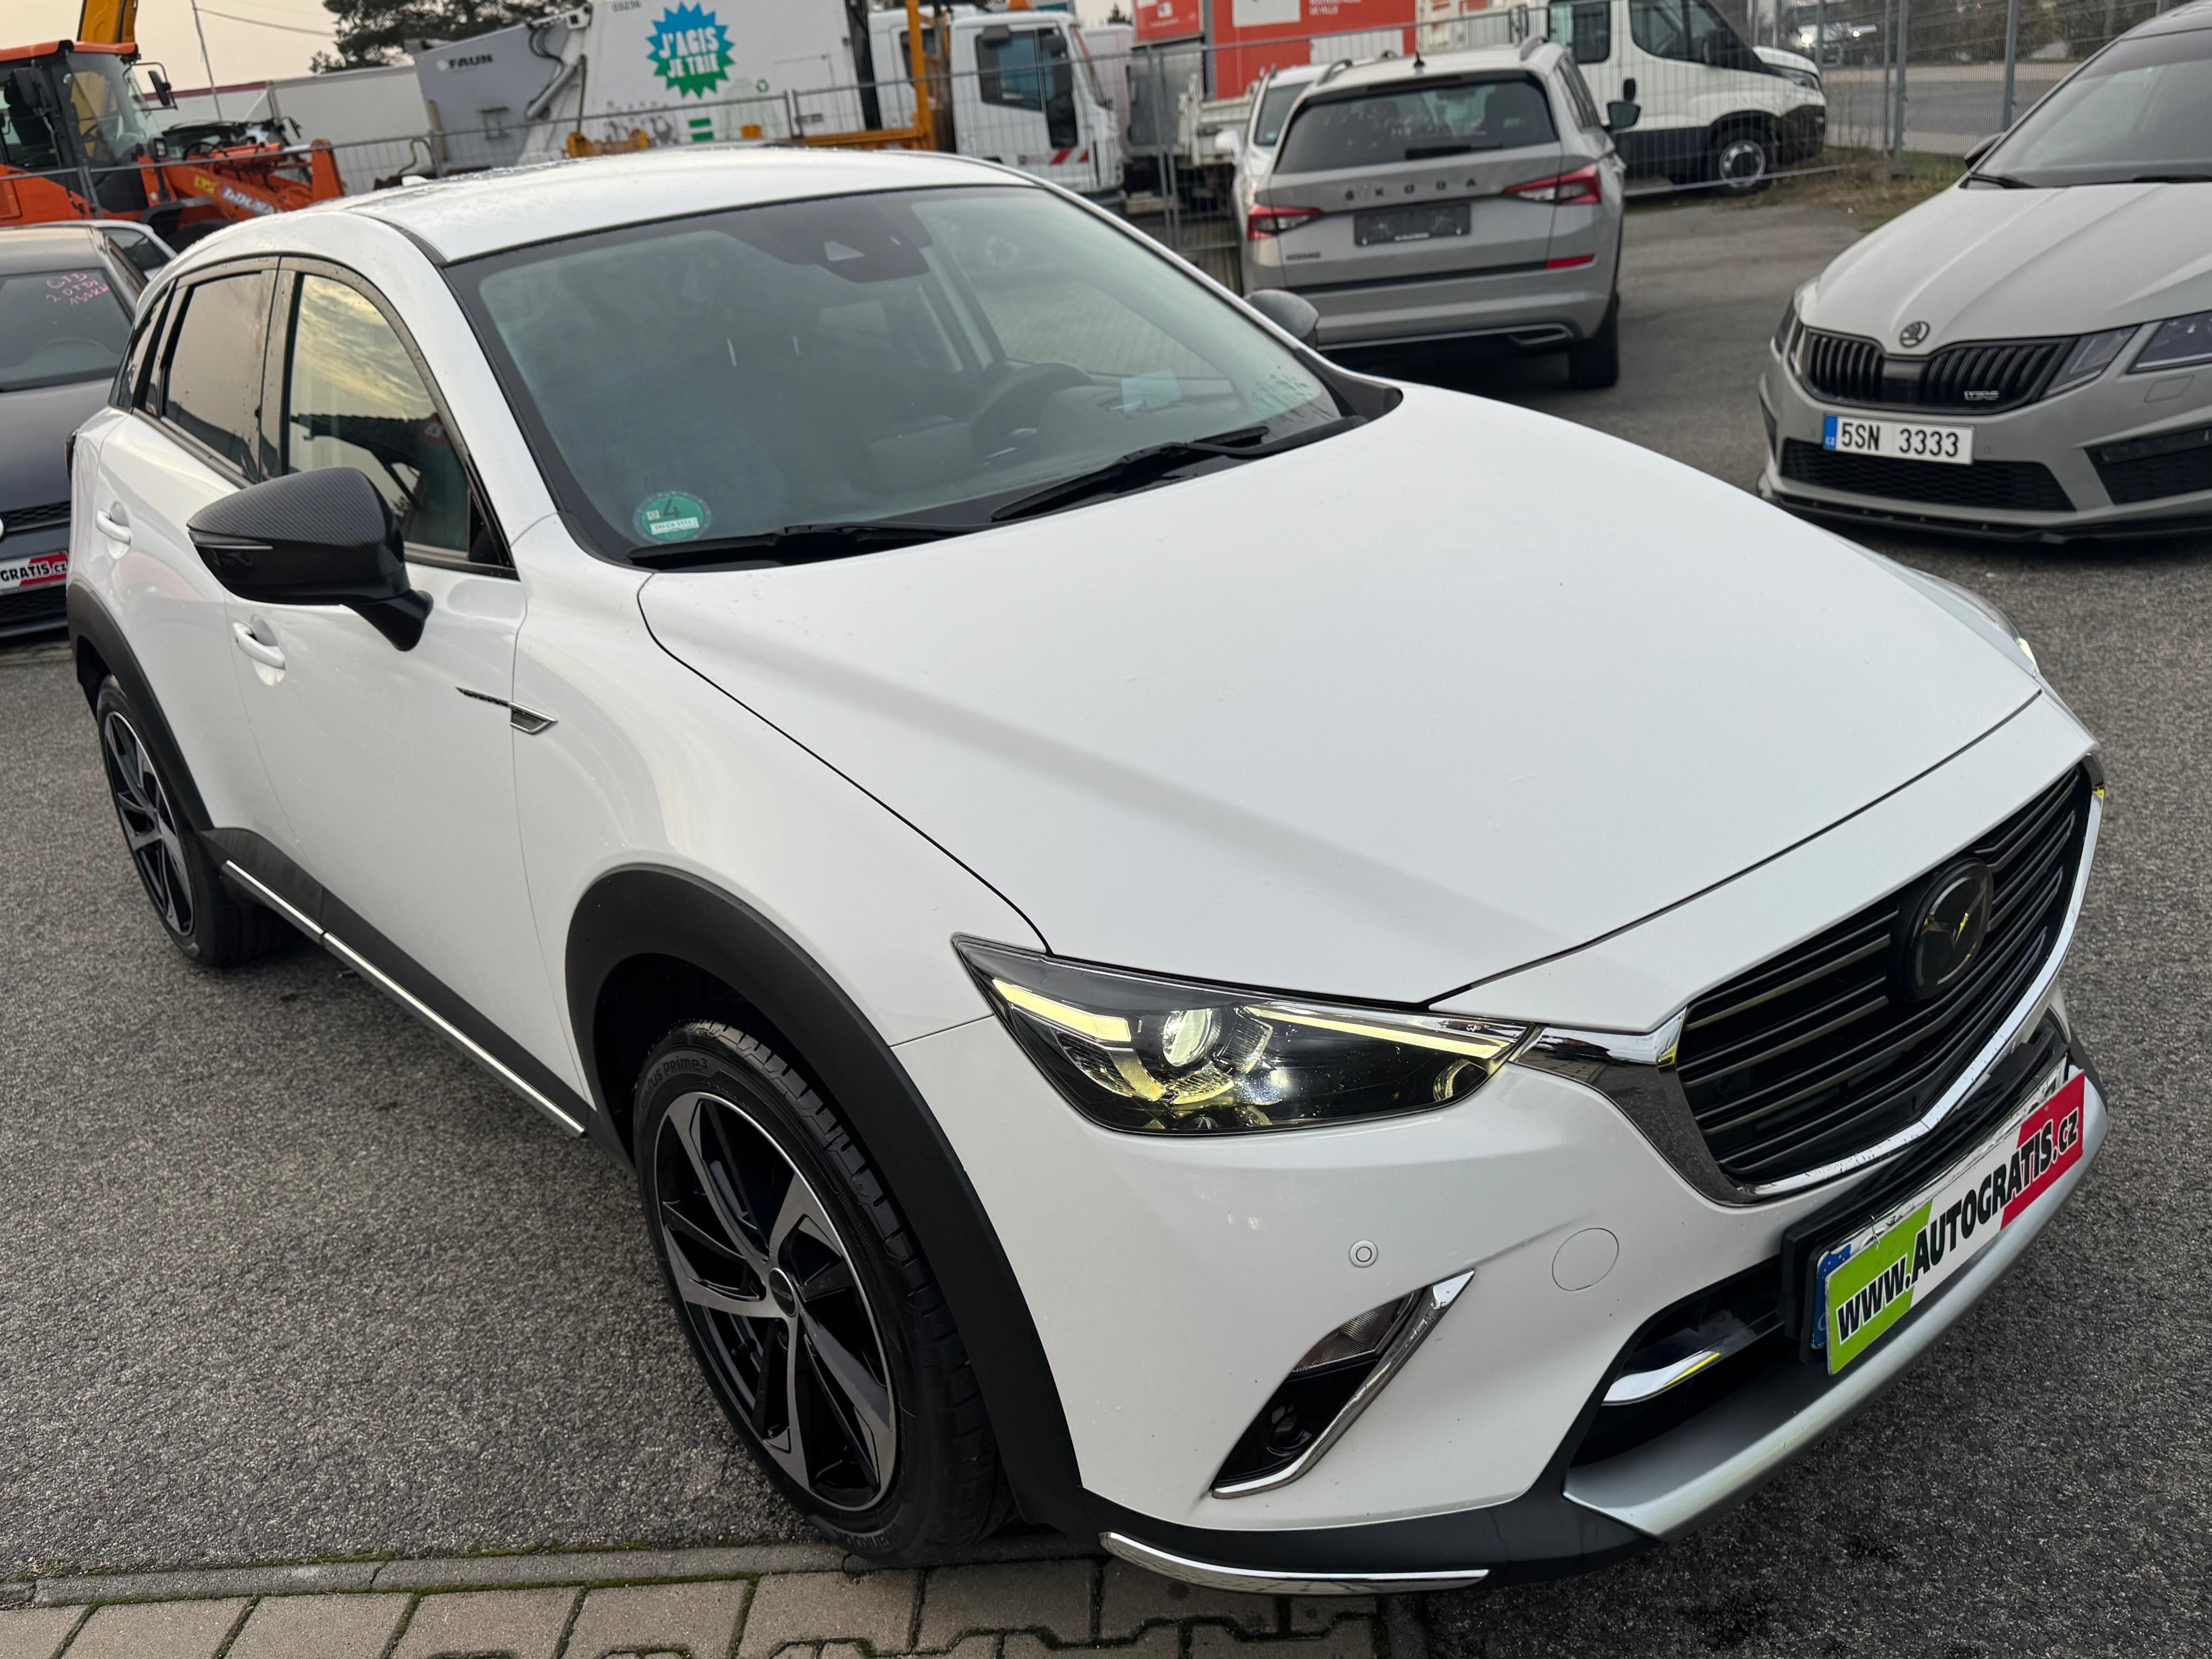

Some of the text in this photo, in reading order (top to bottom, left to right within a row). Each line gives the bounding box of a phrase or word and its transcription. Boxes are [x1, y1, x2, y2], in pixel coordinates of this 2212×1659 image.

[658, 26, 719, 59] J'AGIS
[448, 53, 494, 69] FAUN
[666, 58, 685, 78] JE
[1841, 422, 1959, 457] 5SN 3333
[663, 498, 682, 517] 4
